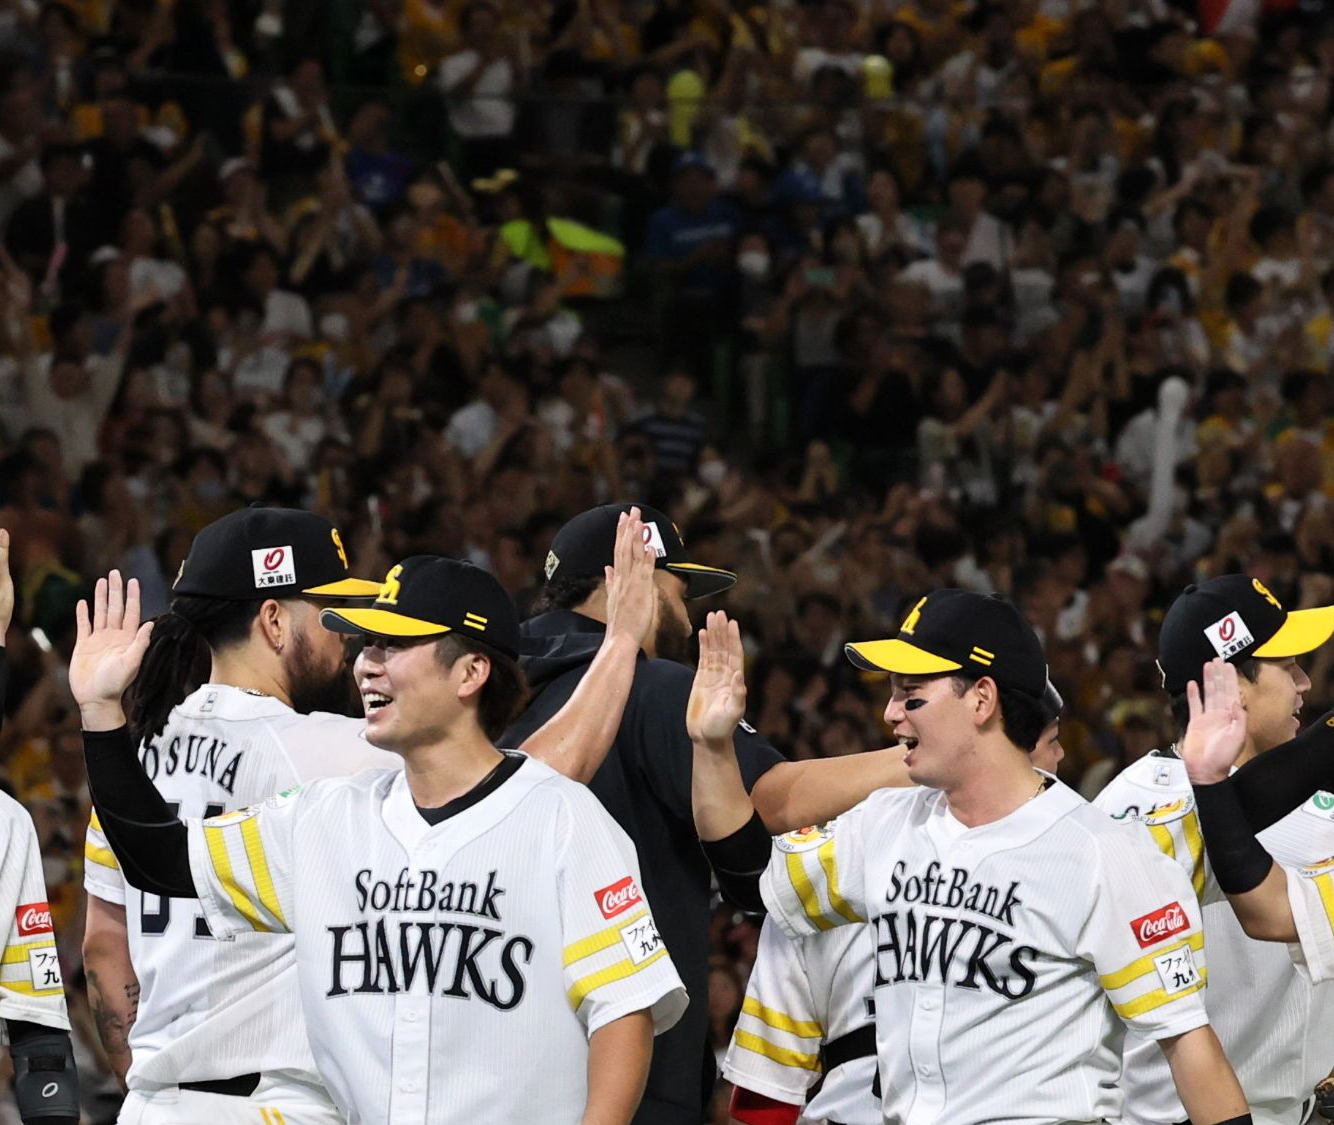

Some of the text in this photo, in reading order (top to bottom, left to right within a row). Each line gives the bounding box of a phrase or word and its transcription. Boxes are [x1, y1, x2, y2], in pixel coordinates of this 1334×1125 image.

[354, 866, 506, 922] SoftBank
[885, 860, 1023, 927] SoftBank
[325, 915, 536, 1013] HAWKS
[870, 907, 1039, 1001] HAWKS
